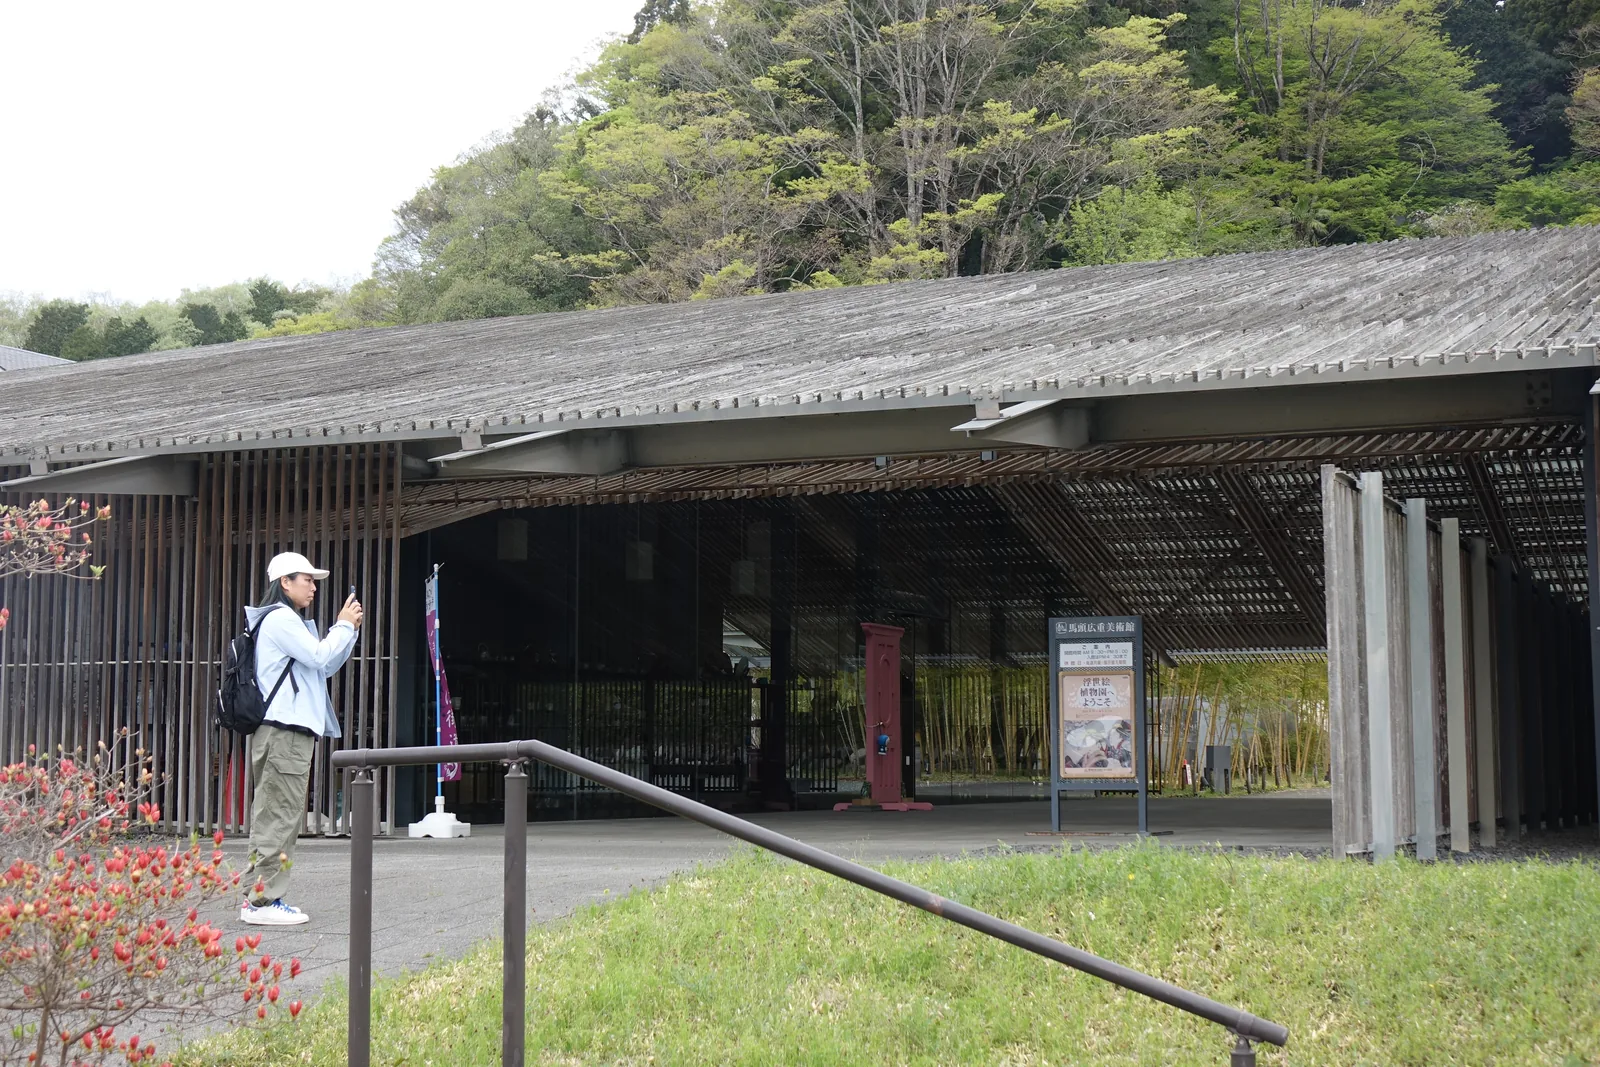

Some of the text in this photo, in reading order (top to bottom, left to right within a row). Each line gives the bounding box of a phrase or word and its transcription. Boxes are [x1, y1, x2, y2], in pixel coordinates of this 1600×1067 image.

[1068, 621, 1135, 633] 馬頭広重美術館
[1082, 677, 1111, 687] 浮世絵
[1080, 687, 1115, 697] 植物園へ
[1082, 697, 1112, 707] ようこそ
